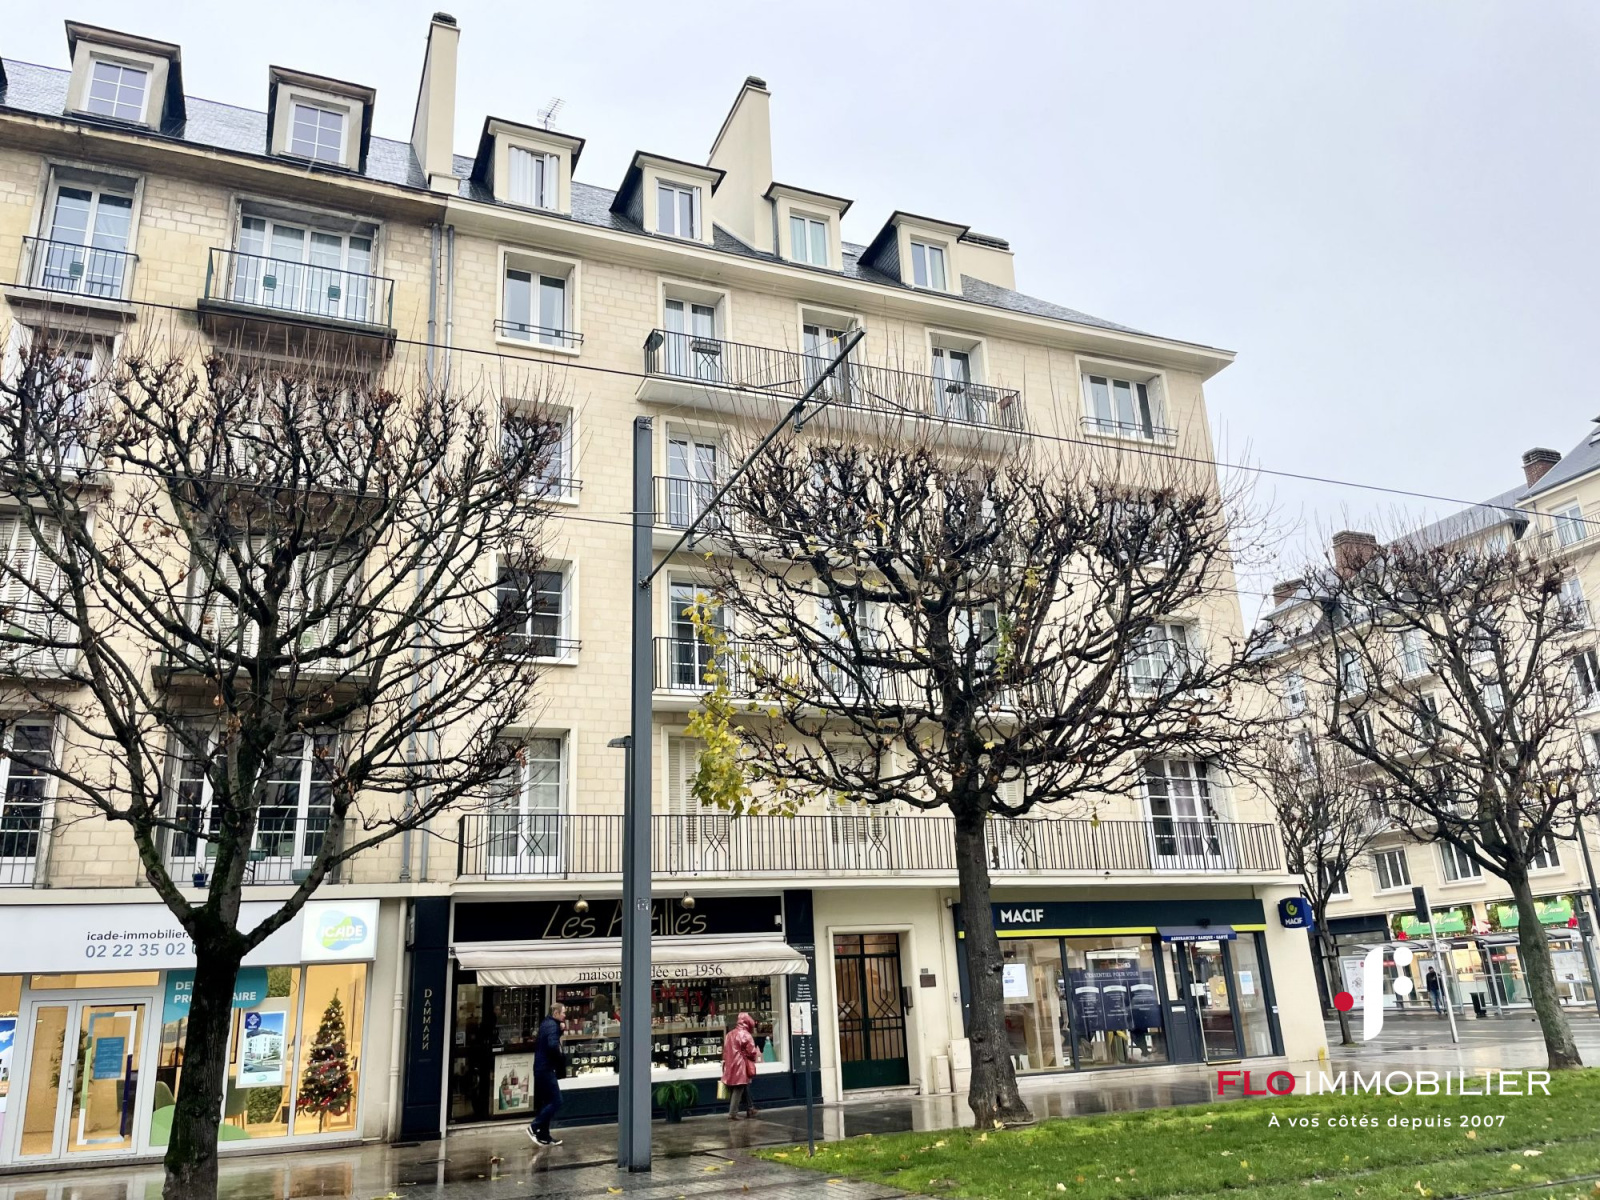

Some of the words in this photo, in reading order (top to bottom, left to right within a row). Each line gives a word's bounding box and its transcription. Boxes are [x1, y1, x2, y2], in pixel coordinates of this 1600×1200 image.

[542, 904, 596, 939] Les
[607, 899, 707, 936] Atilles
[1000, 908, 1044, 923] MACIF
[1285, 917, 1303, 925] MACIF
[87, 930, 190, 941] icade-immobilier.
[85, 944, 107, 958] 02
[112, 944, 134, 957] 22
[139, 943, 160, 956] 35
[165, 942, 186, 956] 02
[579, 968, 622, 981] maison
[674, 967, 688, 977] en
[695, 963, 723, 977] 1956
[422, 988, 433, 1050] DAMMANN
